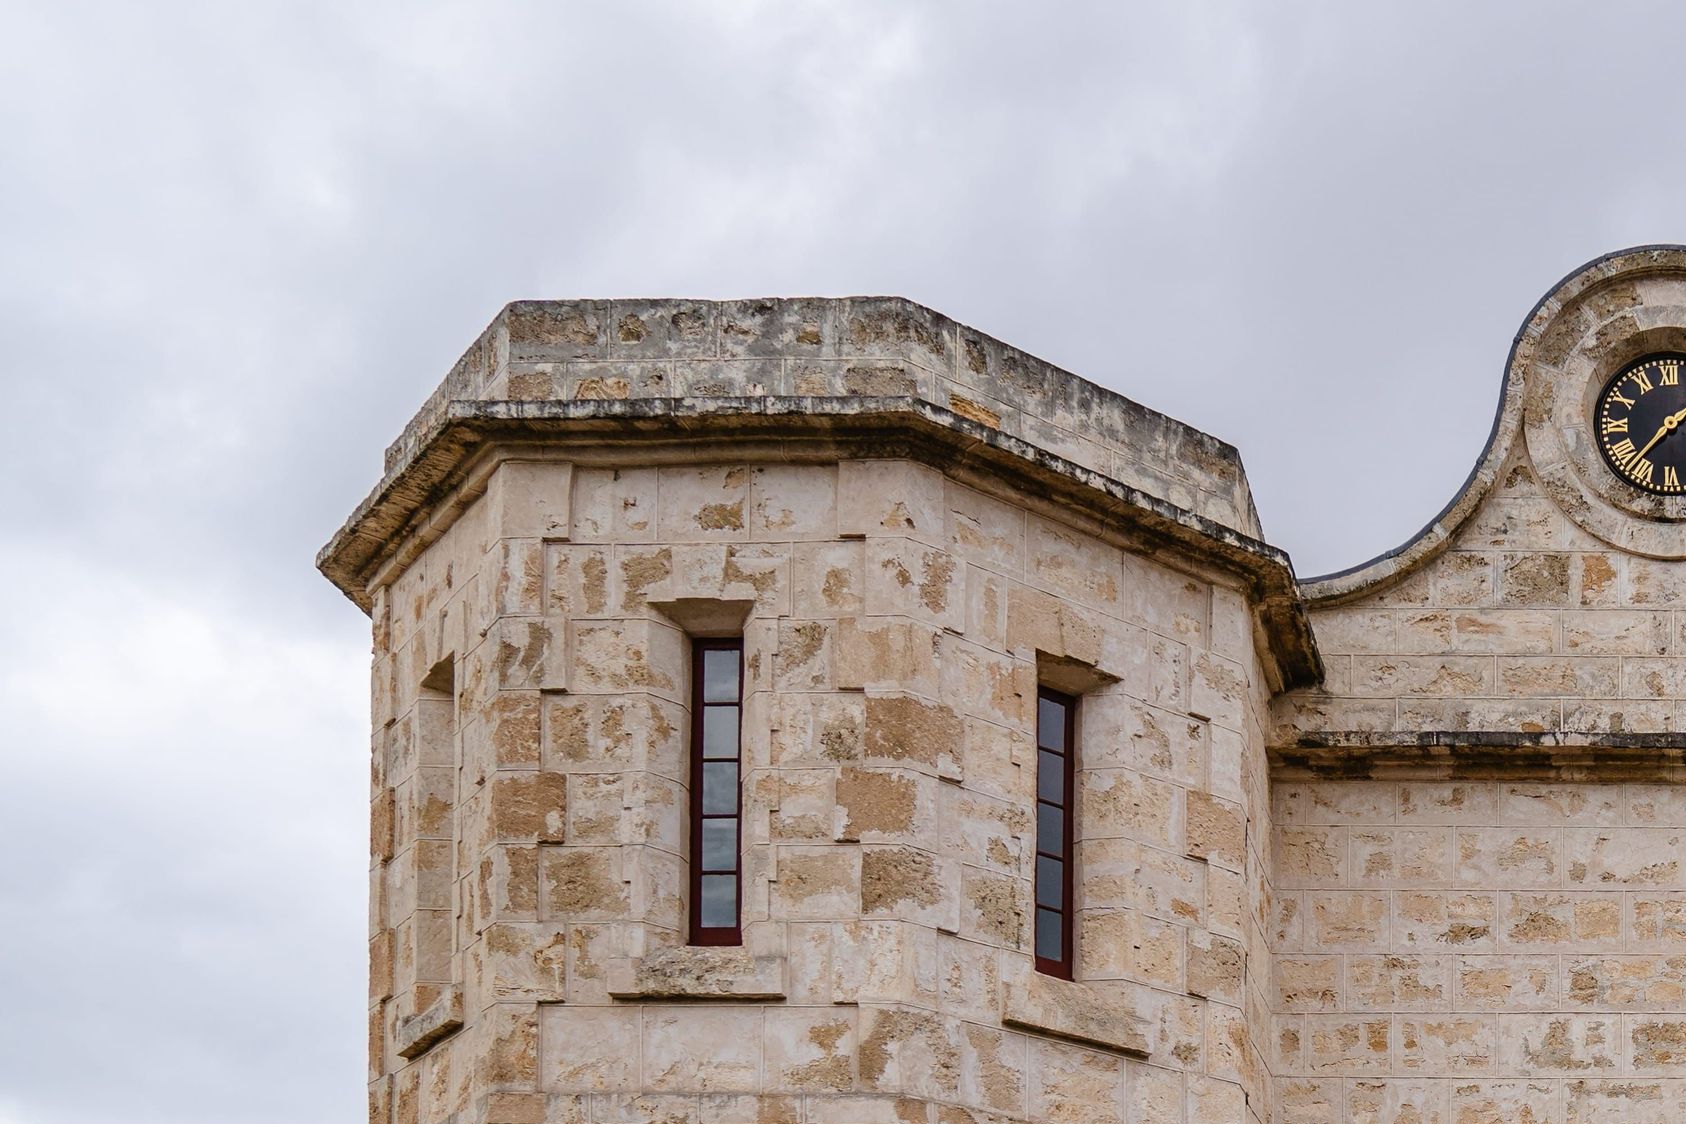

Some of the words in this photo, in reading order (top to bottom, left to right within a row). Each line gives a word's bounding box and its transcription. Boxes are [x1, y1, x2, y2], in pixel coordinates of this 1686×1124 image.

[1632, 370, 1654, 395] XI
[1658, 364, 1679, 386] XII
[1613, 390, 1636, 411] X
[1607, 417, 1628, 433] IX
[1611, 437, 1637, 466] VIII
[1632, 457, 1654, 483] VII
[1664, 466, 1679, 487] VI
